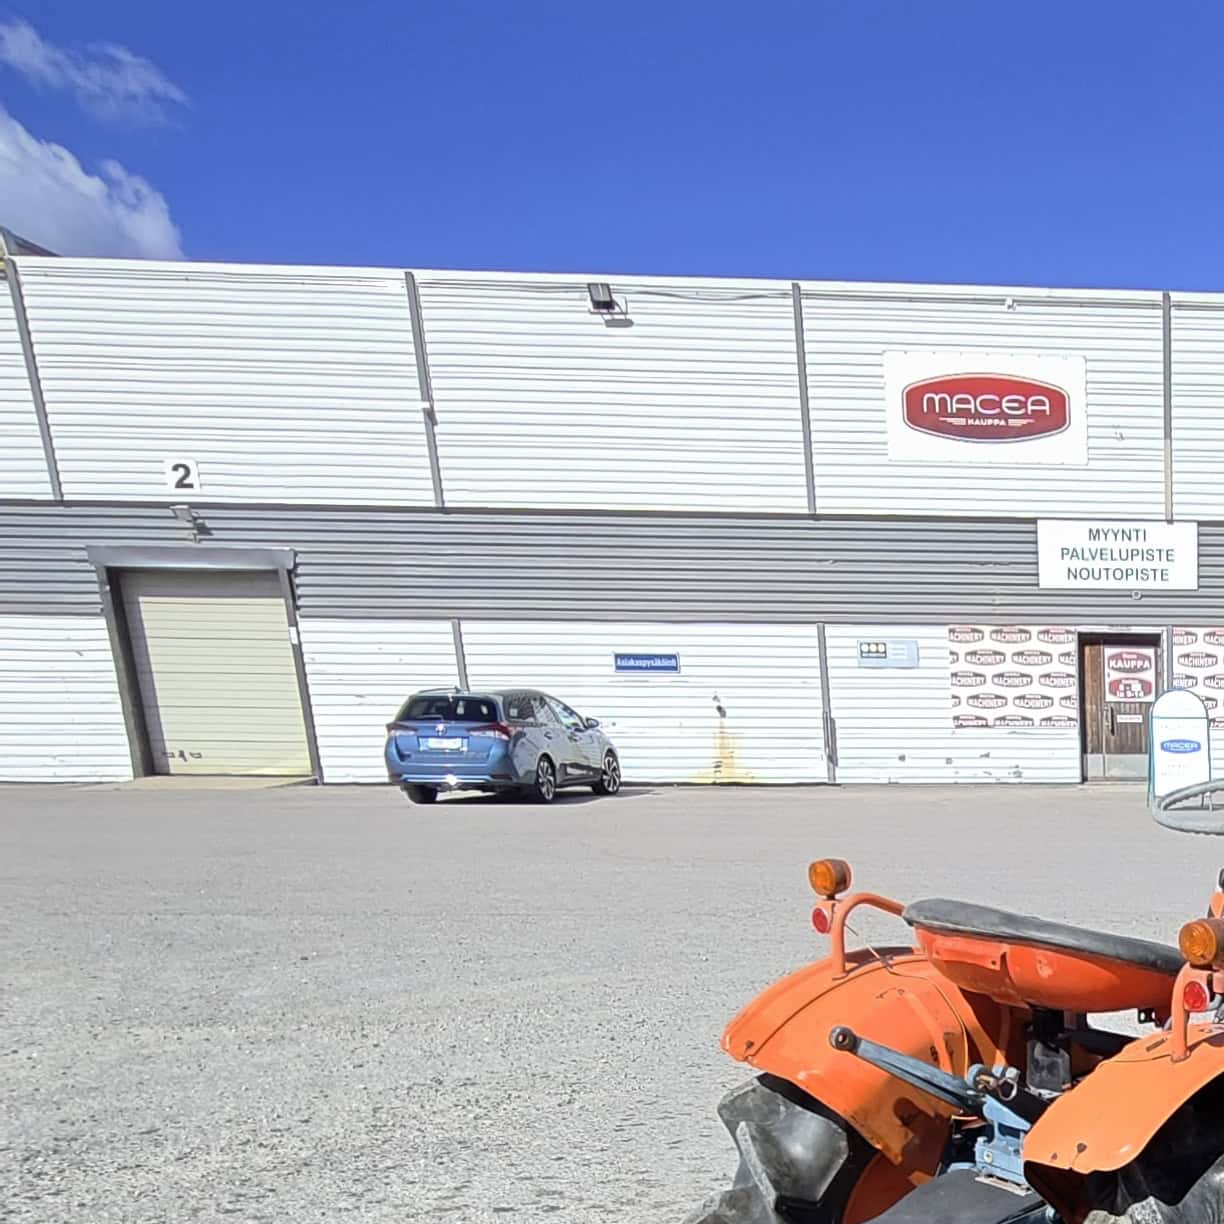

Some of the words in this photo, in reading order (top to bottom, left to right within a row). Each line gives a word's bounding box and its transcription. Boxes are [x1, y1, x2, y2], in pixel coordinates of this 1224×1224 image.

[923, 392, 1050, 416] MACEA
[967, 418, 1008, 427] KAUPPA
[171, 463, 194, 489] 2
[1088, 527, 1147, 542] MYYNTI
[1060, 547, 1176, 562] PALVELUPISTE
[1067, 567, 1169, 582] NOUTOPISTE
[1109, 660, 1151, 669] KAUPPA
